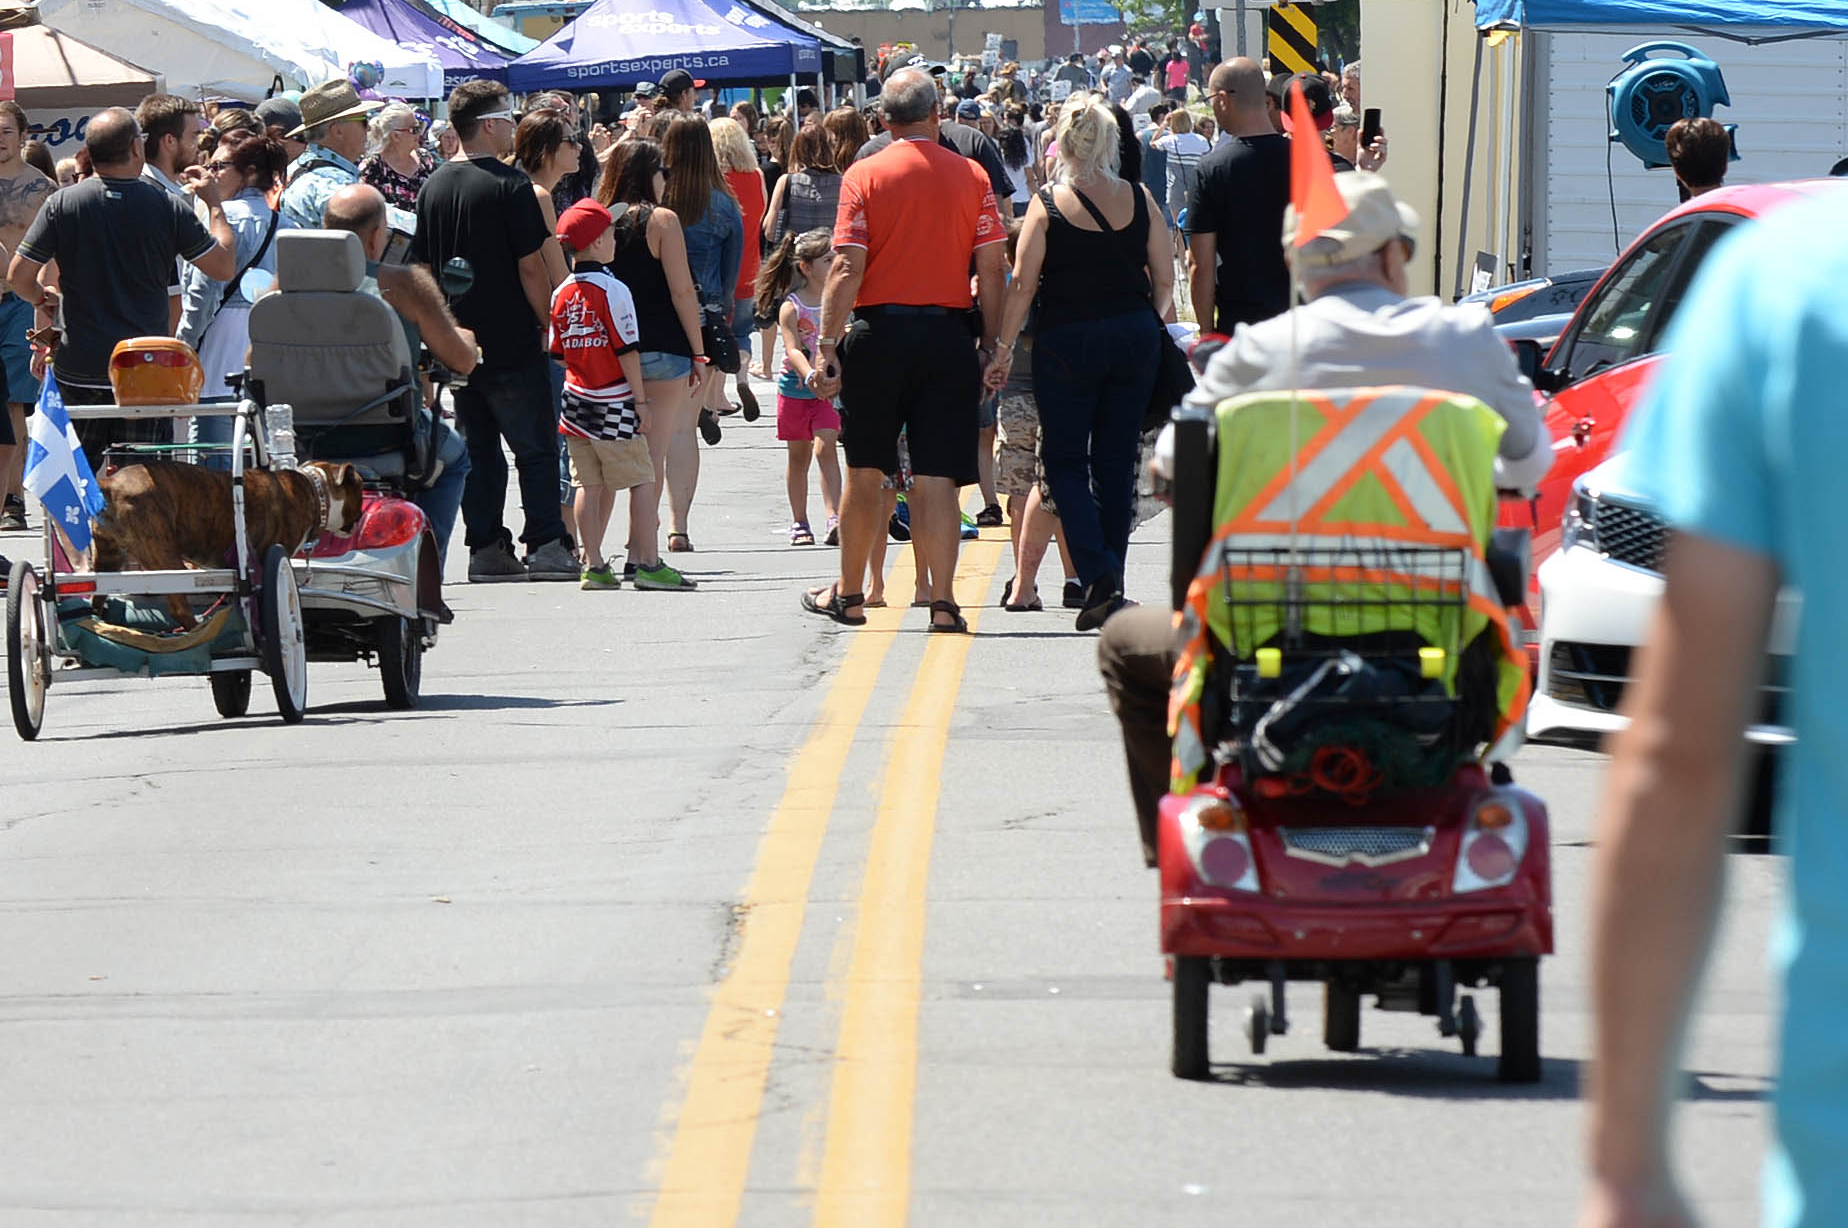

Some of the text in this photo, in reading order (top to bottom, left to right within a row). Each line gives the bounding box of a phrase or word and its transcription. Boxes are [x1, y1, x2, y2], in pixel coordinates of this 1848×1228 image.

[586, 10, 675, 28] sports
[618, 23, 721, 36] experts
[567, 55, 730, 78] sportsexperts.ca
